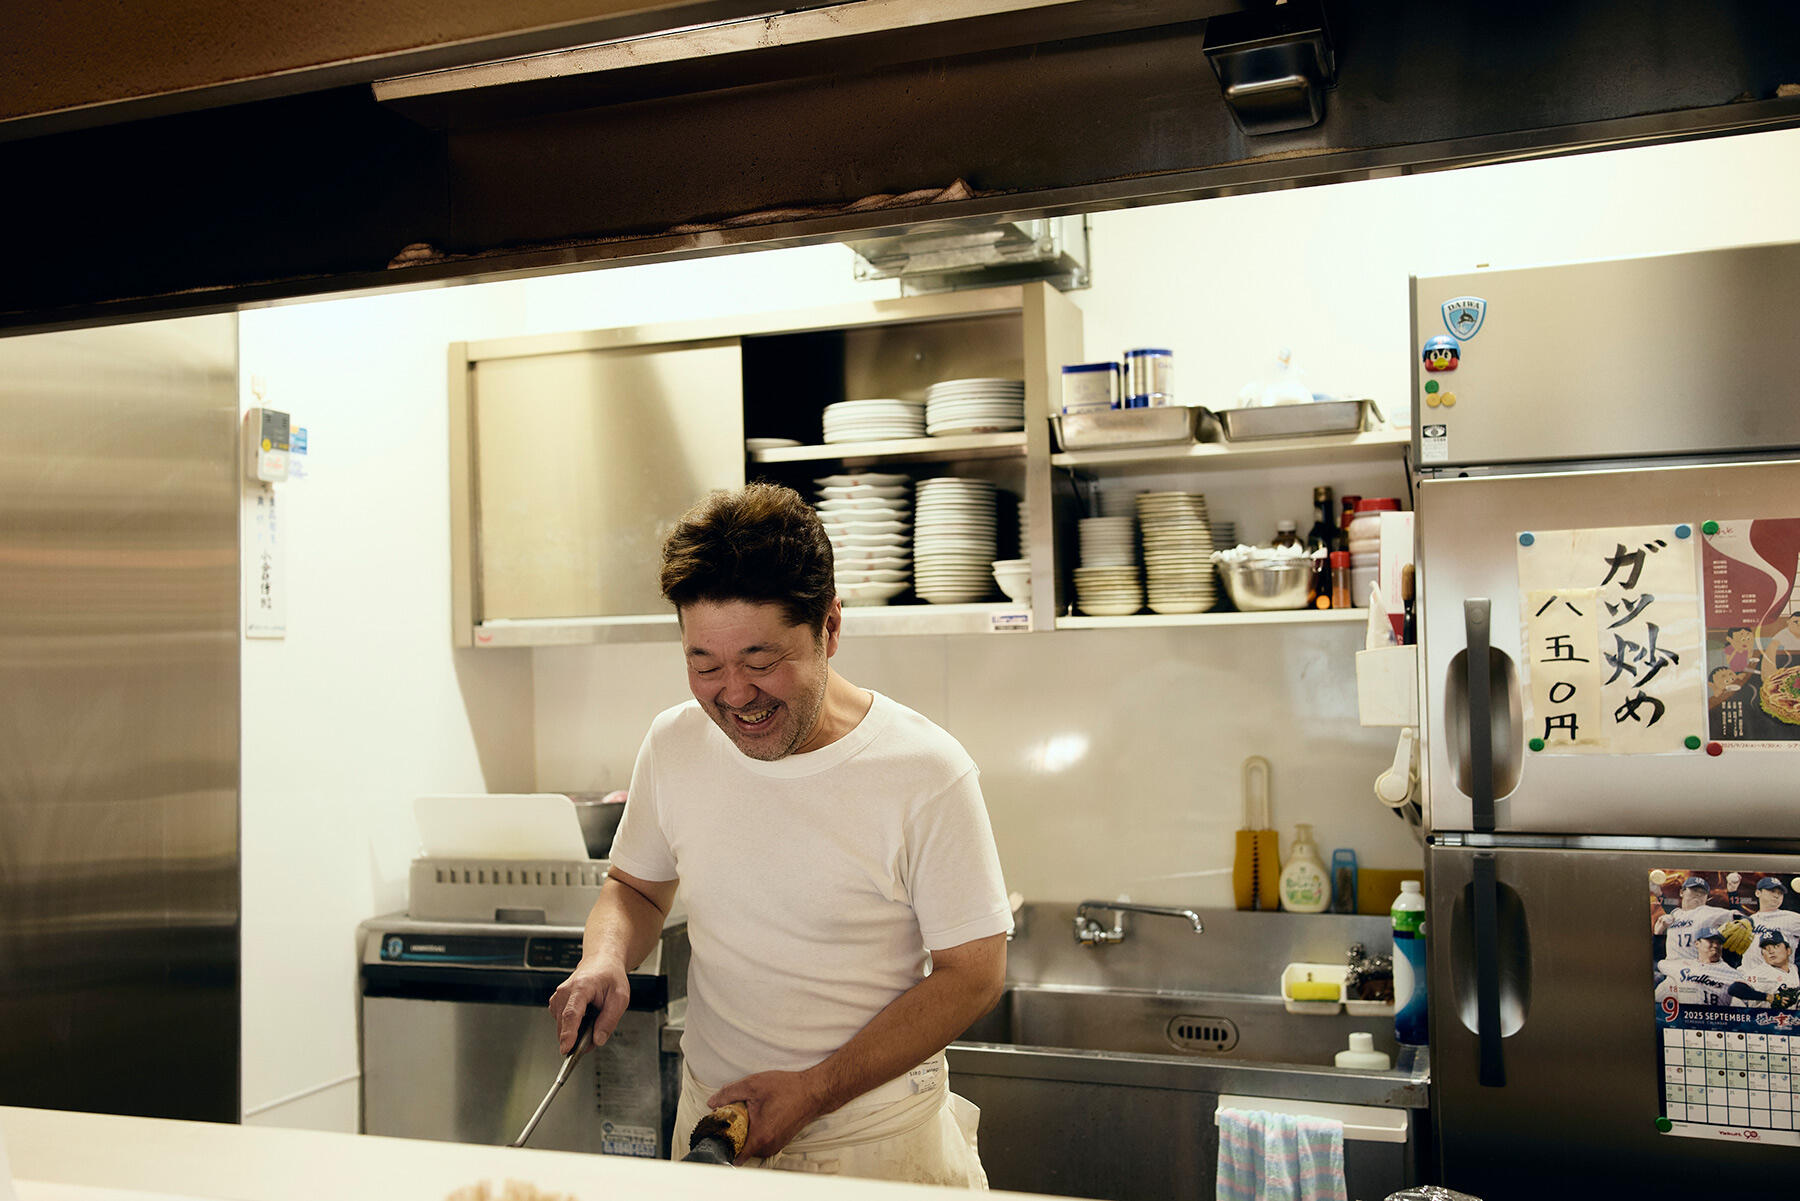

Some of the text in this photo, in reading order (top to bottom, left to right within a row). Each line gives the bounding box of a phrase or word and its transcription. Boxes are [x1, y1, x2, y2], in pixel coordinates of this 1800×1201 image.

[1448, 301, 1480, 310] DAIWA
[1600, 539, 1679, 728] ガツ炒め
[1677, 933, 1692, 947] 17
[1680, 968, 1725, 988] Swallows
[1662, 996, 1679, 1022] 9
[1684, 1011, 1704, 1020] 2025
[1705, 1012, 1751, 1022] SEPTEMBER
